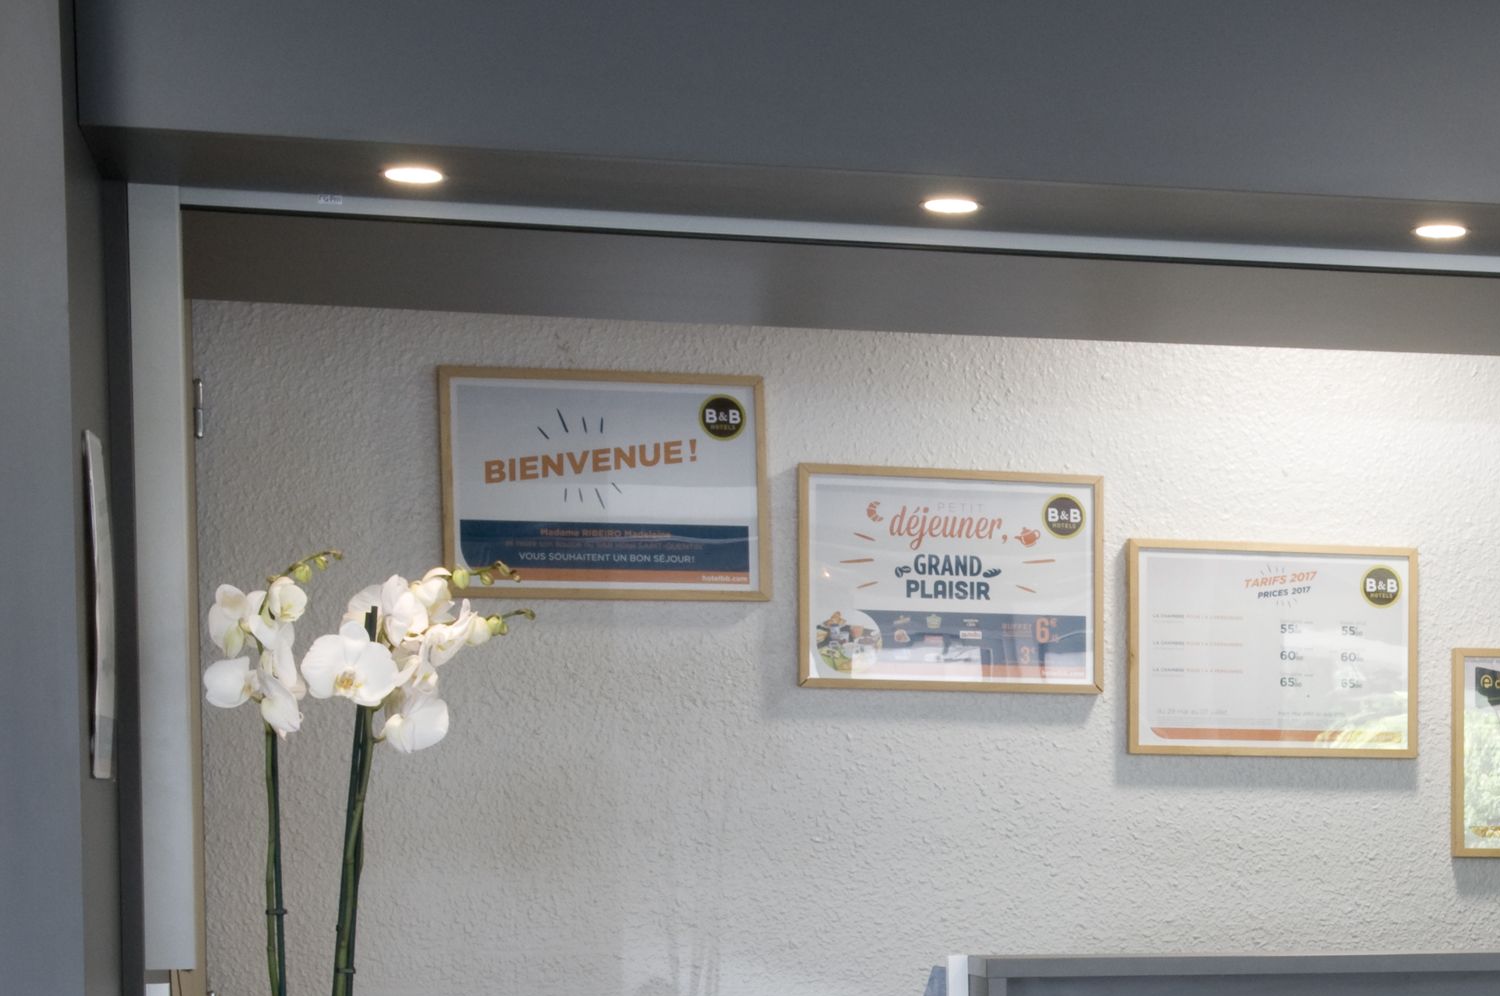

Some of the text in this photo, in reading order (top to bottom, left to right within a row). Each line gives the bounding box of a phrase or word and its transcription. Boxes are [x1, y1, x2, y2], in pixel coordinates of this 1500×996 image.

[705, 409, 741, 424] B&B
[938, 503, 984, 513] PETIT
[1048, 508, 1081, 523] B&B
[519, 552, 546, 561] VOUS
[548, 552, 610, 562] SOUHAITENT
[613, 554, 627, 562] UN
[629, 554, 651, 563] BON
[914, 553, 982, 577] GRAND
[1244, 571, 1318, 589] TARIFS 2017
[1366, 578, 1398, 592] B&B
[906, 579, 991, 601] PLAISIR
[1258, 586, 1311, 600] PRICES 2017
